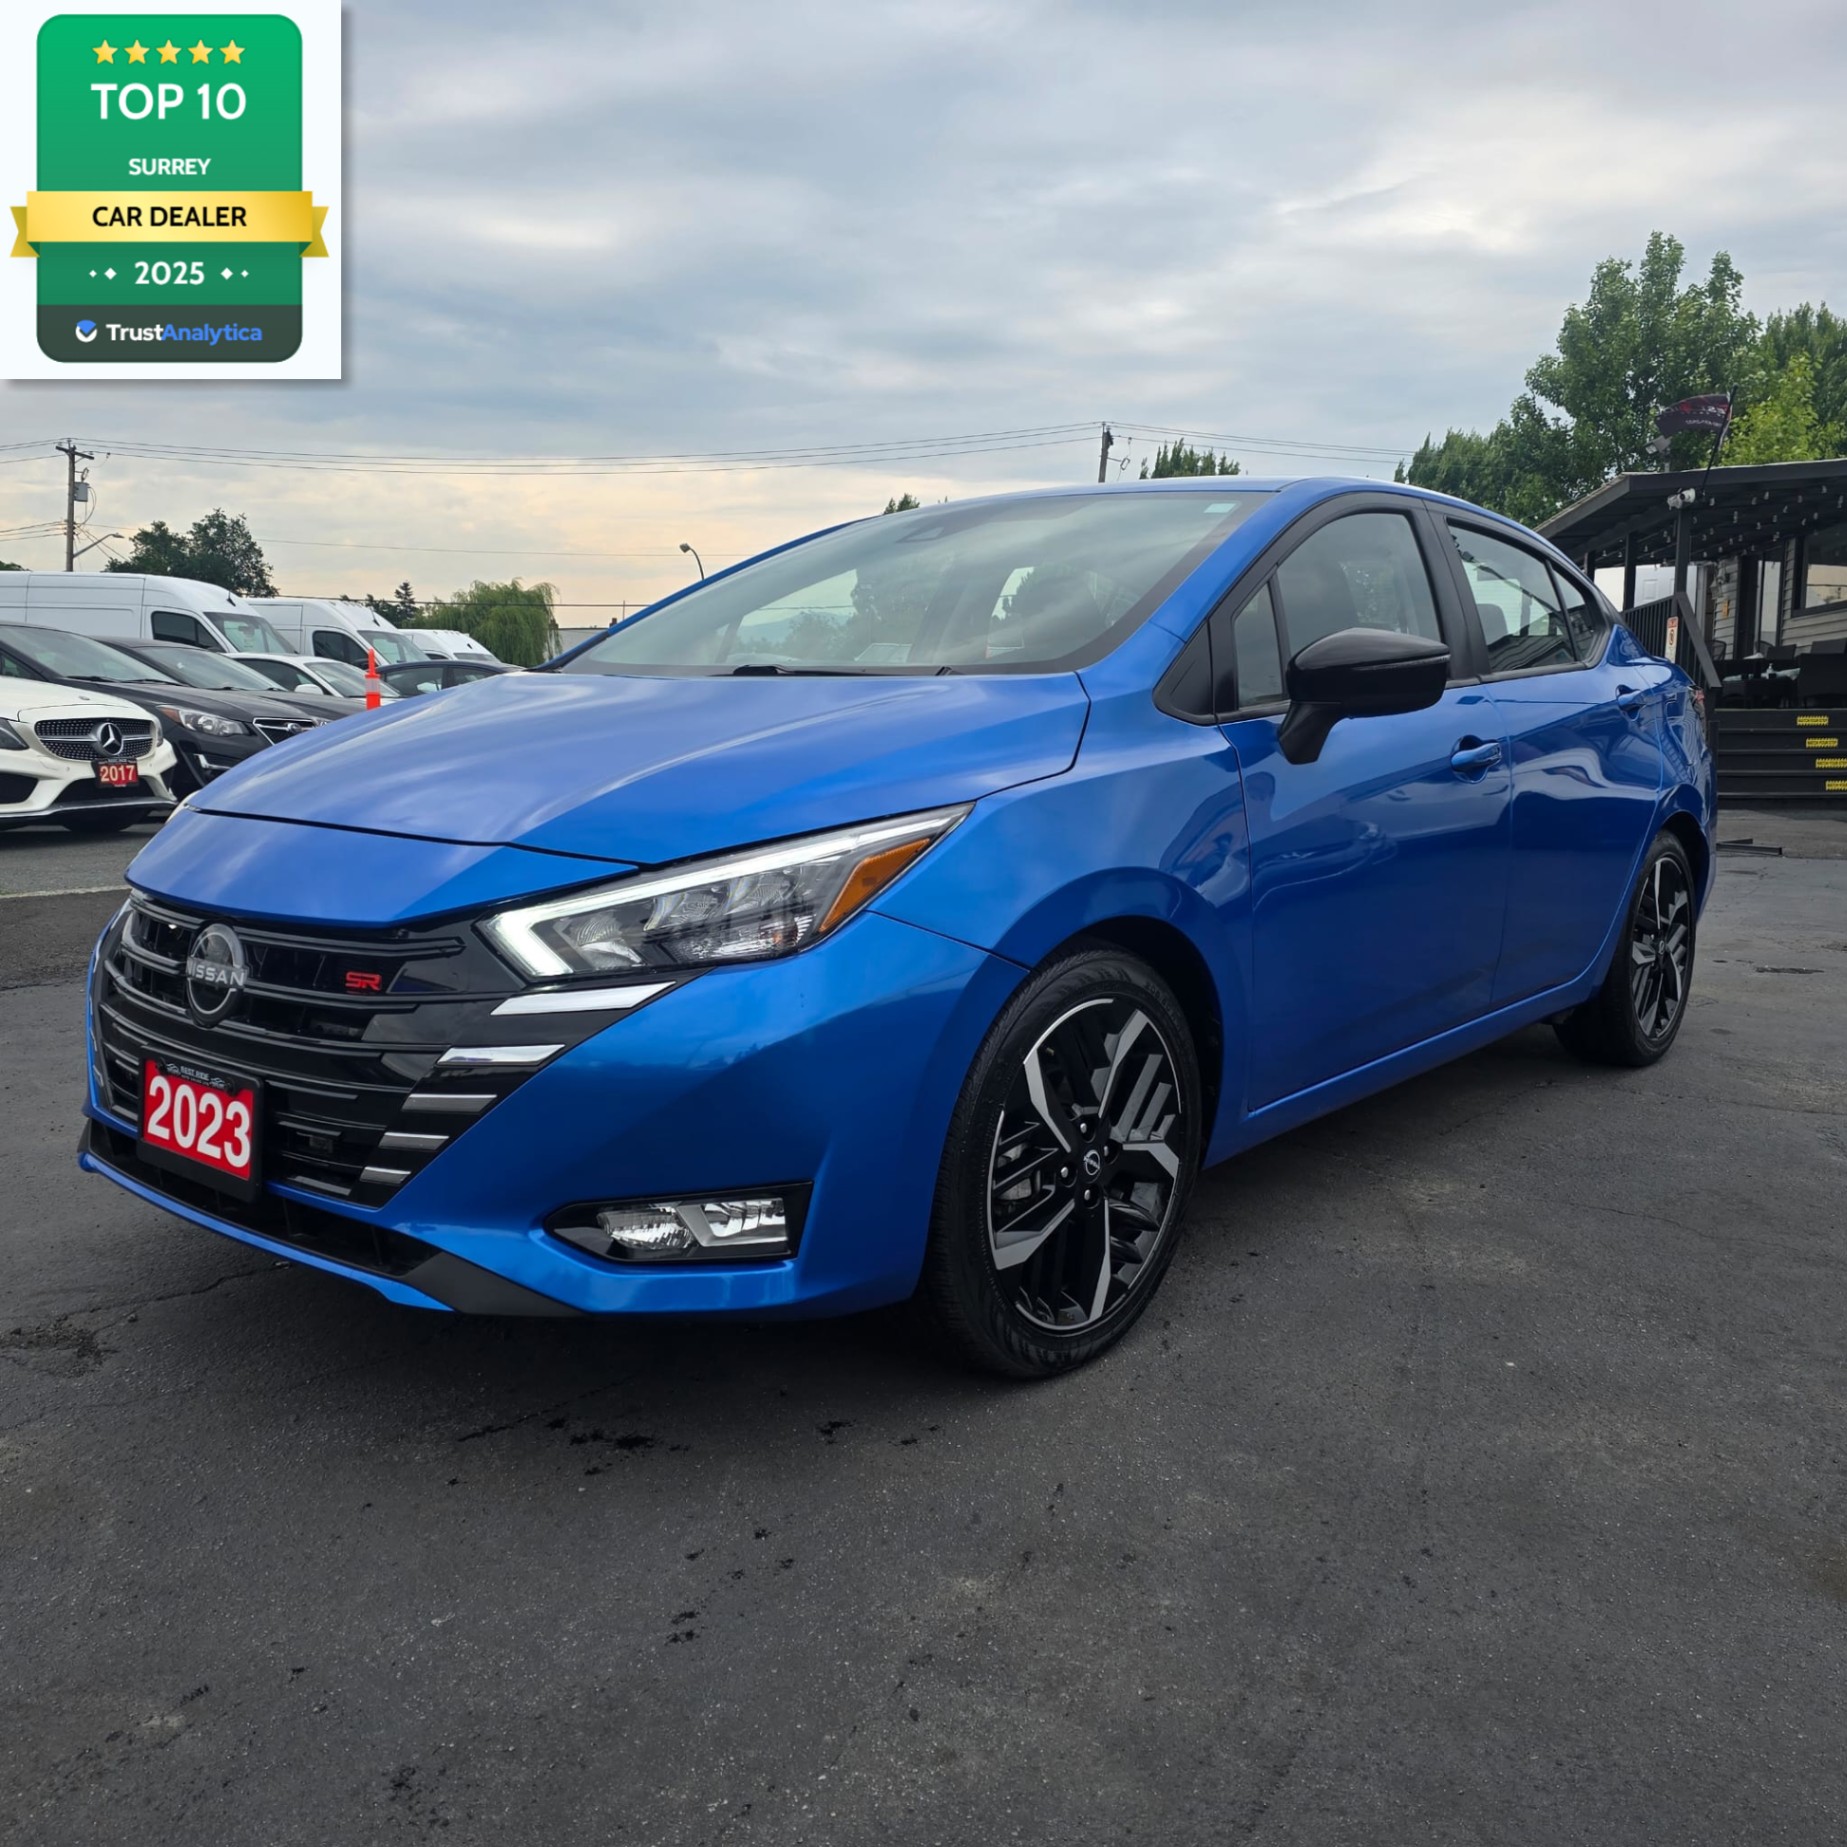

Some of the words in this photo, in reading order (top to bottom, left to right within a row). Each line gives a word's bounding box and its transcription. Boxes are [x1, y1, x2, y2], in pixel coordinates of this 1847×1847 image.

[100, 764, 135, 782] 2017
[187, 957, 245, 986] NISSAN
[345, 971, 381, 991] SR
[147, 1075, 251, 1168] 2023
